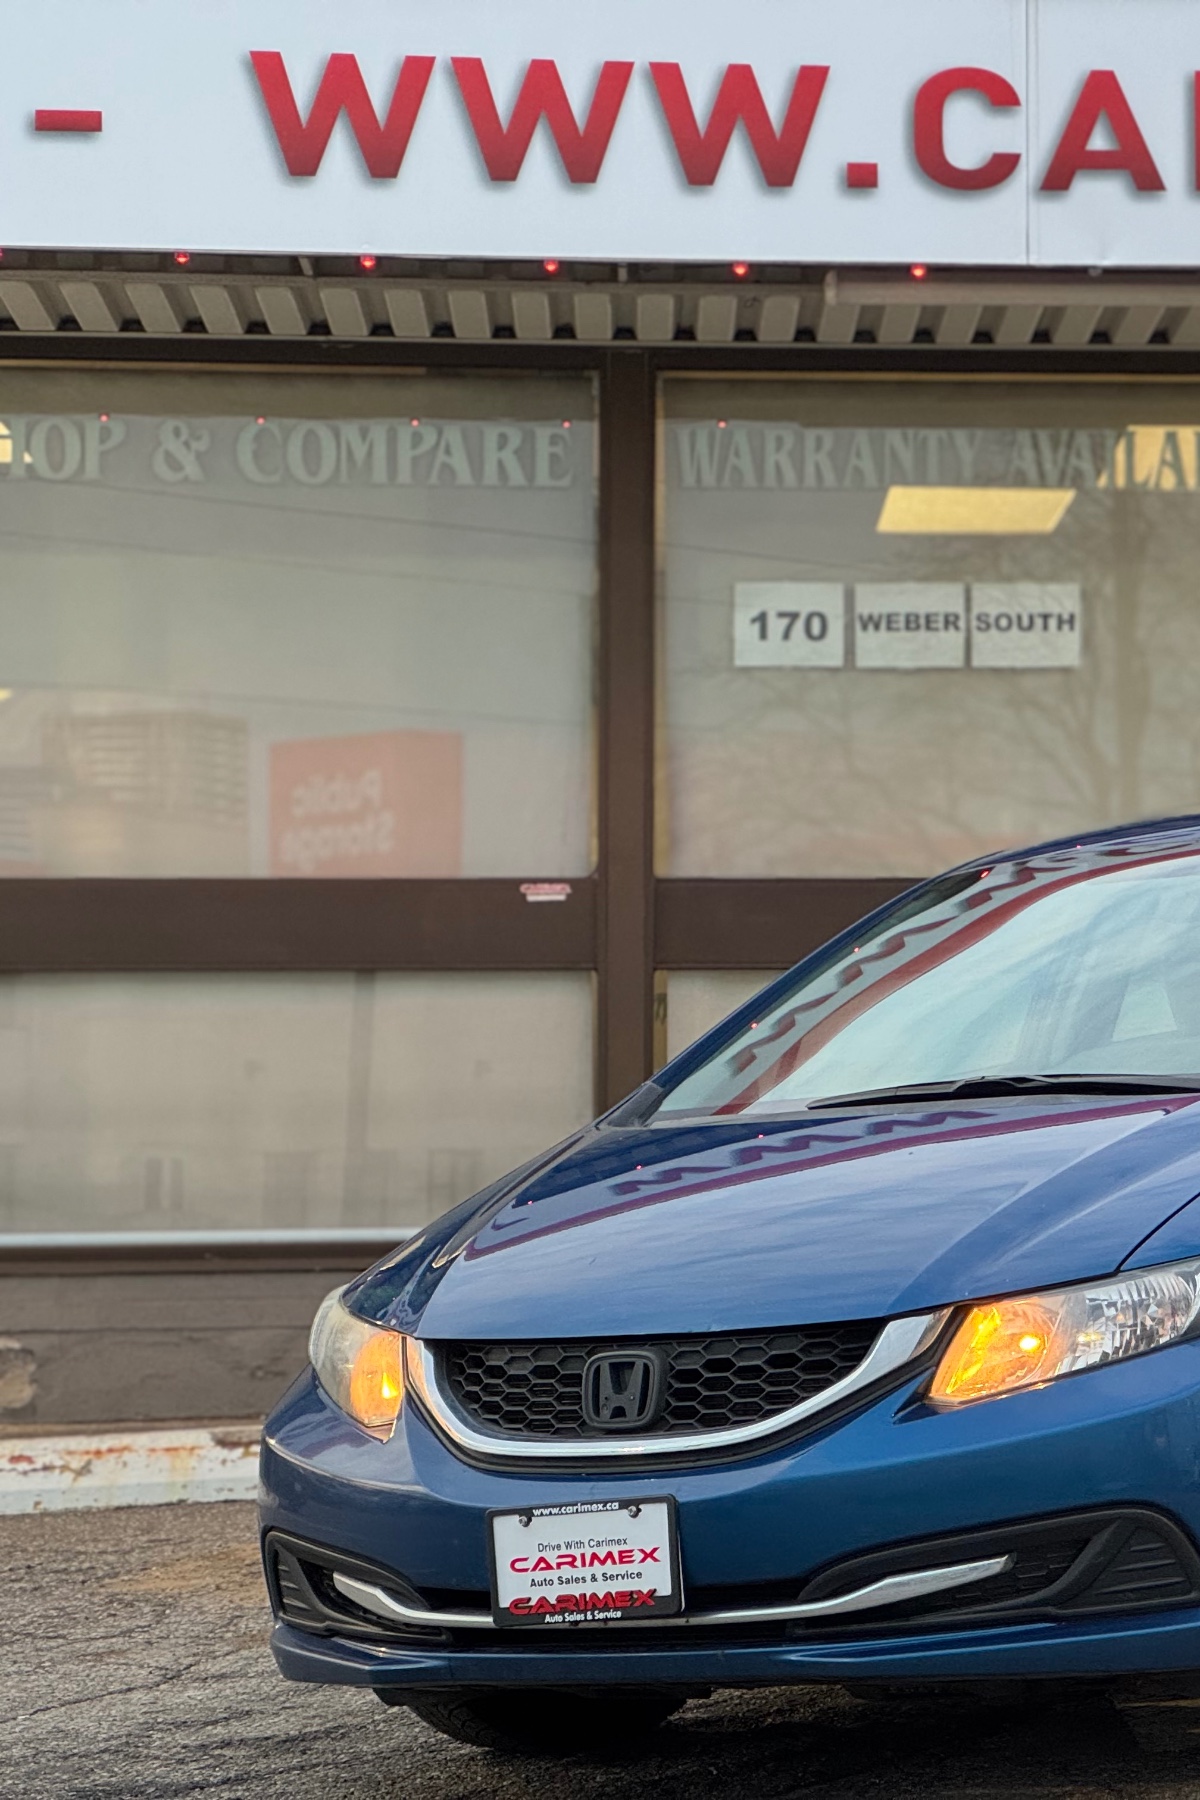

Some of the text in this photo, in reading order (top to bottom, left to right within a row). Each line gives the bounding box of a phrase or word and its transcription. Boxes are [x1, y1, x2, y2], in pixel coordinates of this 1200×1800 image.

[152, 420, 209, 482] &
[236, 421, 573, 487] COMPARE
[676, 427, 979, 488] WARRANTY
[750, 611, 828, 642] 170
[858, 613, 961, 633] WEBER
[974, 612, 1076, 633] SOUTH
[532, 1501, 620, 1517] www.carimex.ca
[537, 1537, 628, 1553] Drive With Carimex
[509, 1547, 661, 1573] CARIMEX
[530, 1569, 643, 1588] Auto Sales & Service
[508, 1588, 658, 1615] CARIMEX
[544, 1609, 622, 1624] Auto Sales & Service
